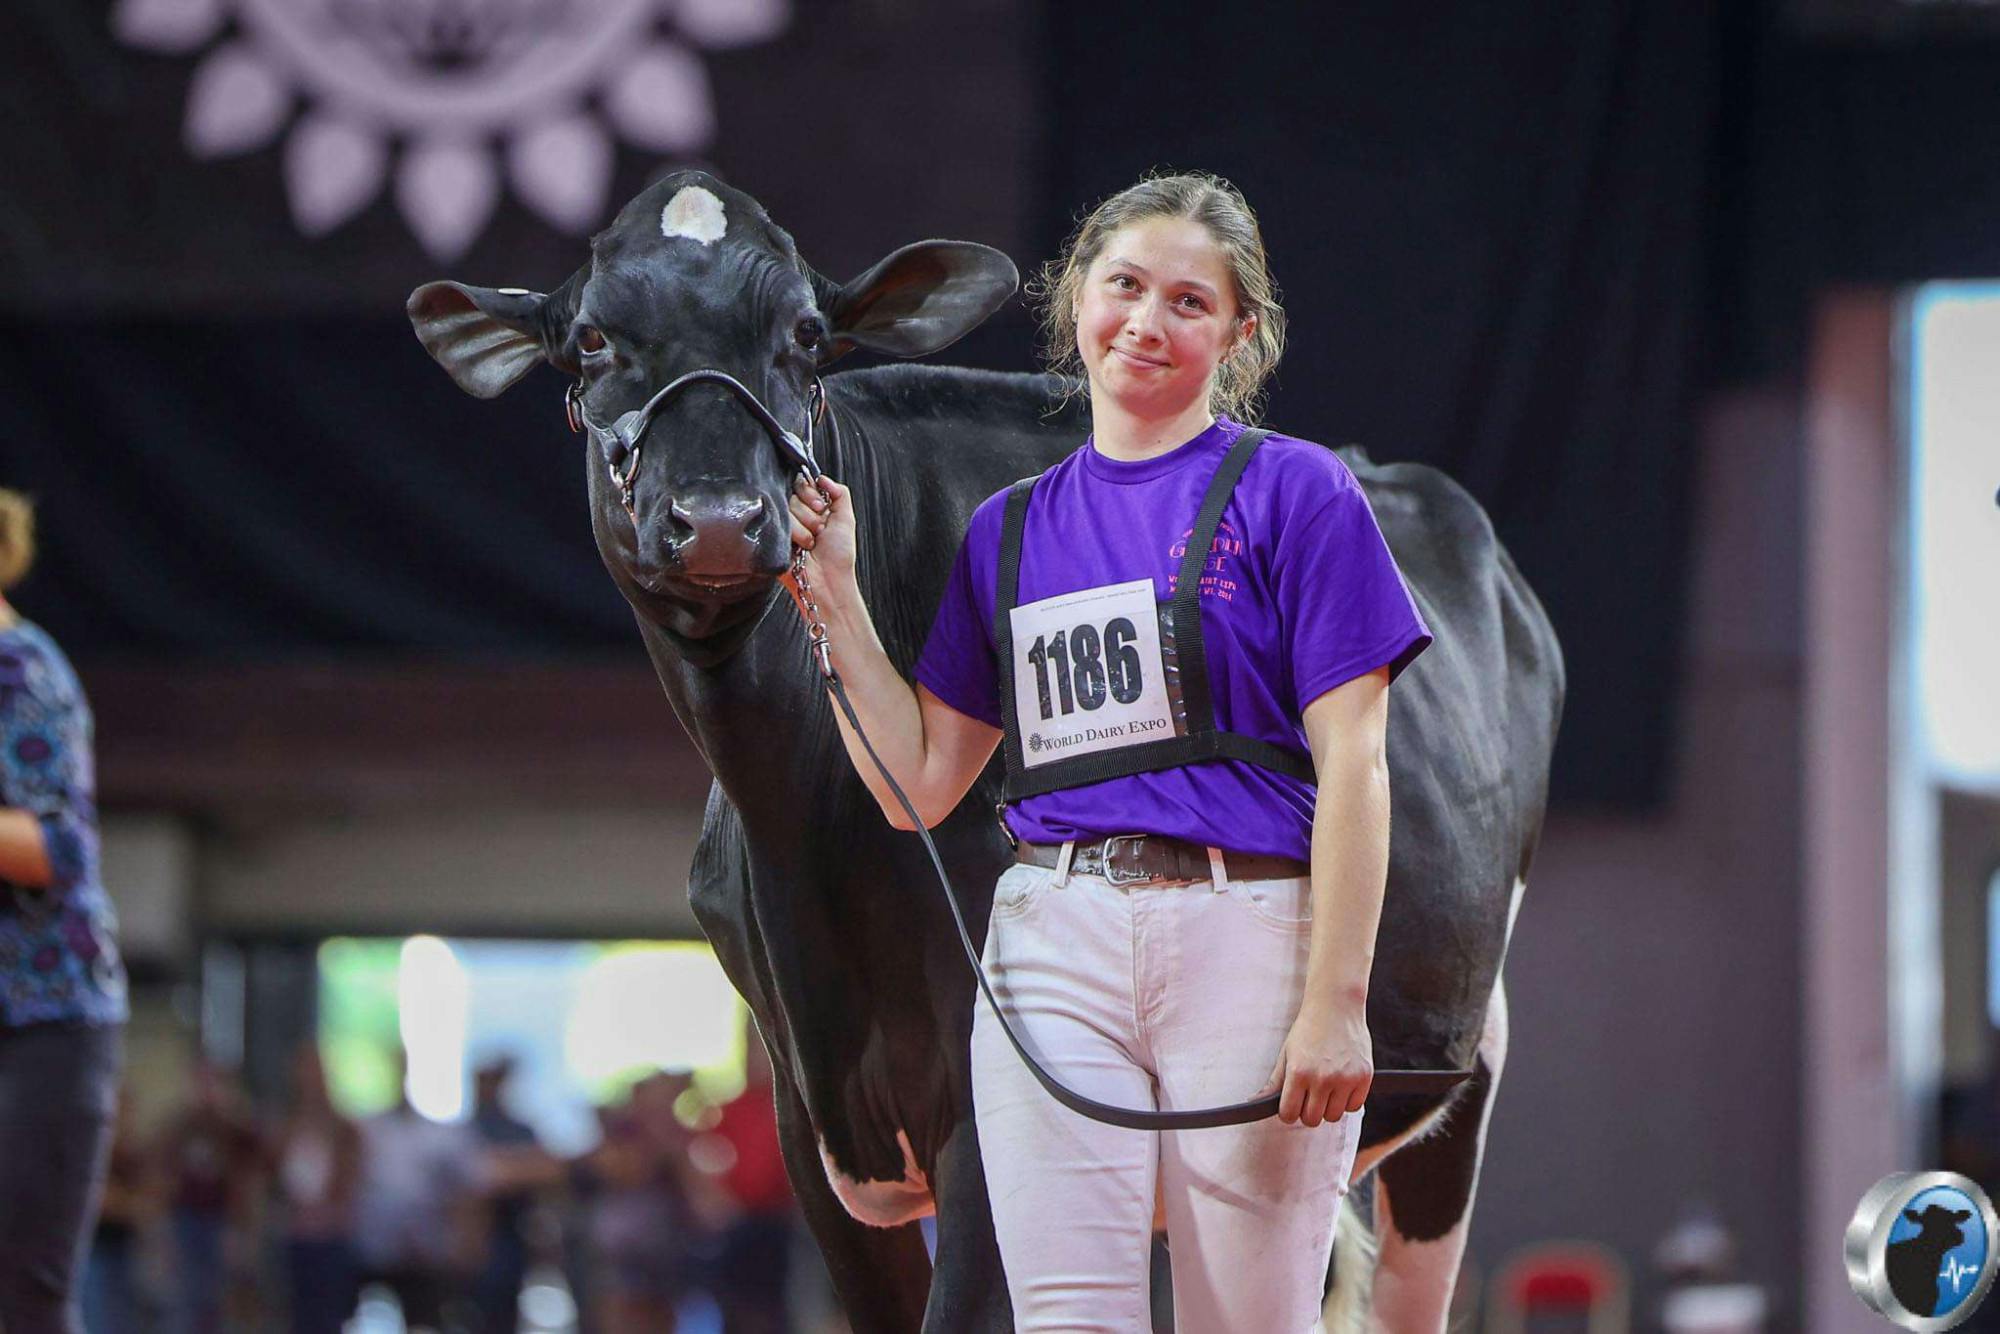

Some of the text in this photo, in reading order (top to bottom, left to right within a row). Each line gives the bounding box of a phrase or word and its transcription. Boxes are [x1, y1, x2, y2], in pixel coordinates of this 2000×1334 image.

[1028, 617, 1143, 721] 1186
[1042, 718, 1167, 751] WORLD DAIRY EXPO
